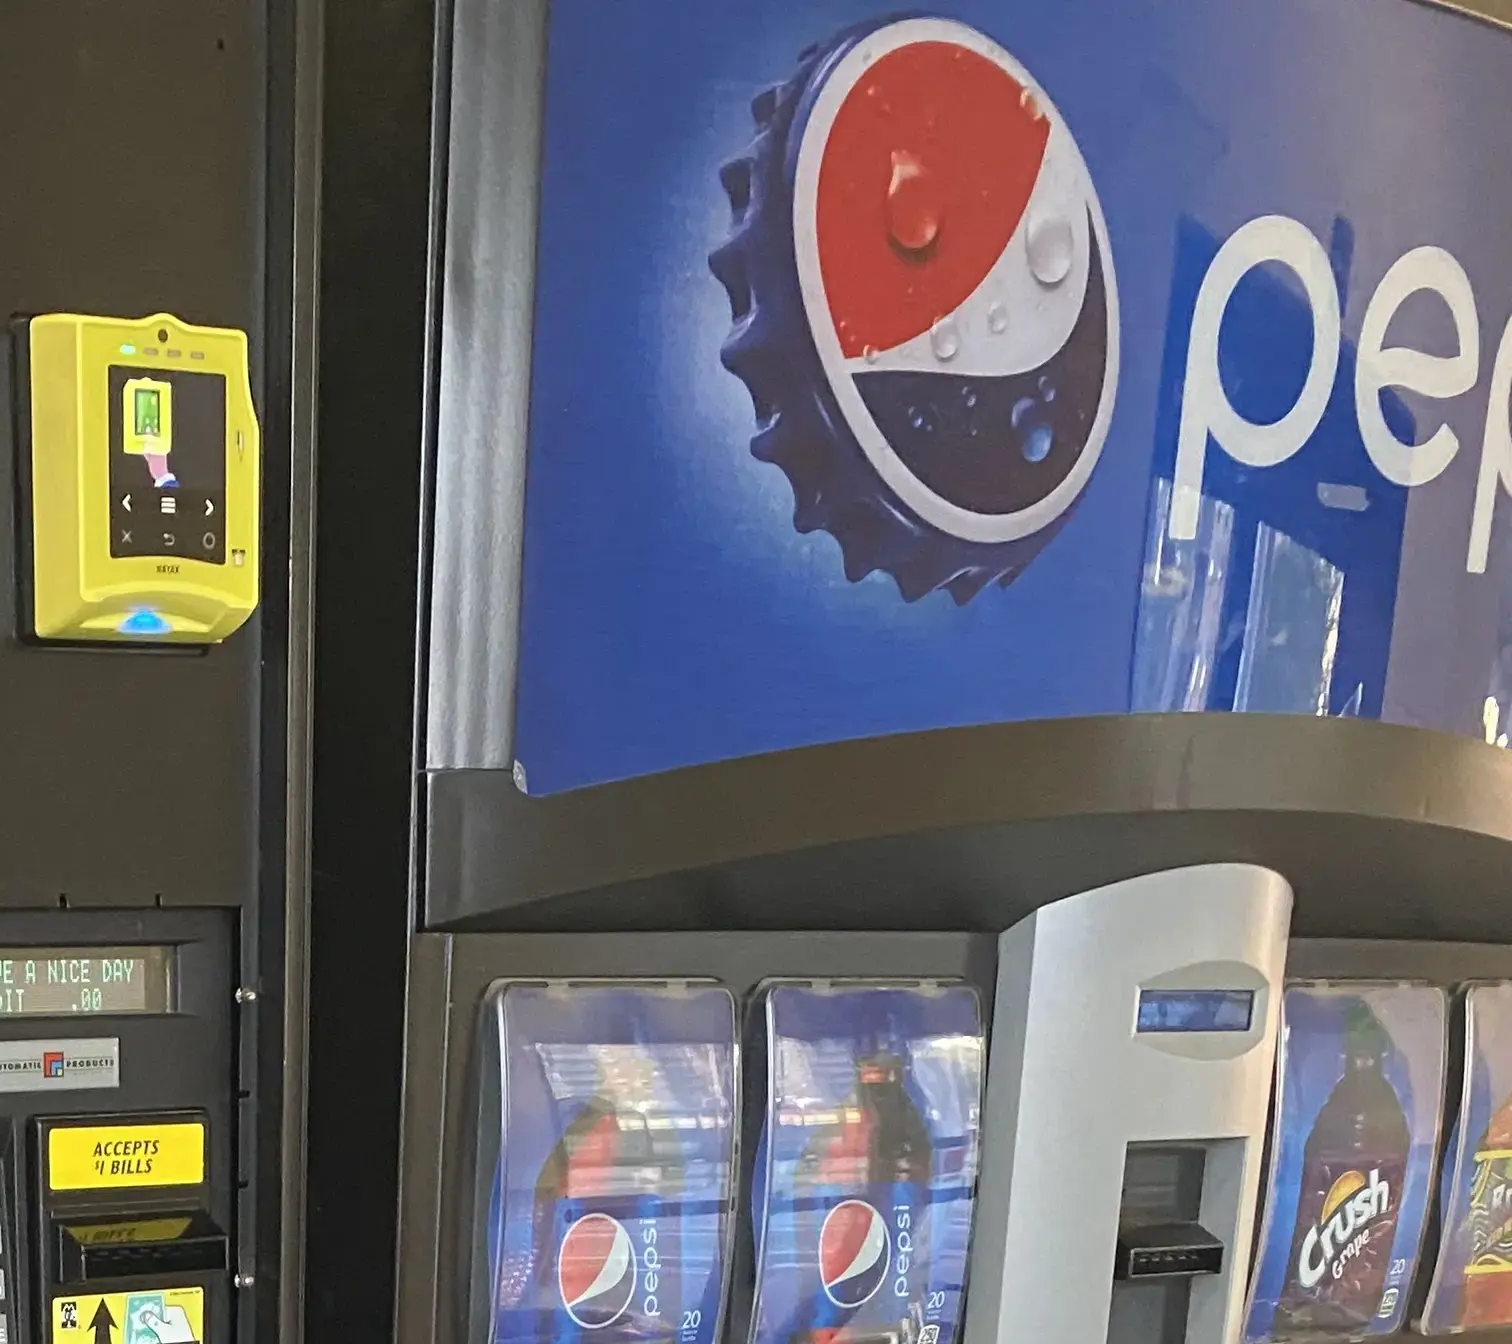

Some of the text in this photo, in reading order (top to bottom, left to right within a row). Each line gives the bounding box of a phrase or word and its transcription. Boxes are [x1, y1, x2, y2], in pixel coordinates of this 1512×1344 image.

[25, 960, 37, 984] A
[47, 959, 91, 984] NICE
[101, 958, 135, 984] DAY
[92, 1139, 160, 1158] ACCEPTS
[94, 1158, 154, 1176] $1 BILLS
[1296, 1169, 1390, 1290] Crush
[893, 1202, 912, 1298] pepsi
[1331, 1226, 1371, 1281] Grape
[640, 1217, 661, 1317] pepsi
[1389, 1259, 1406, 1275] 20
[926, 1291, 946, 1309] 20
[682, 1309, 702, 1329] 20
